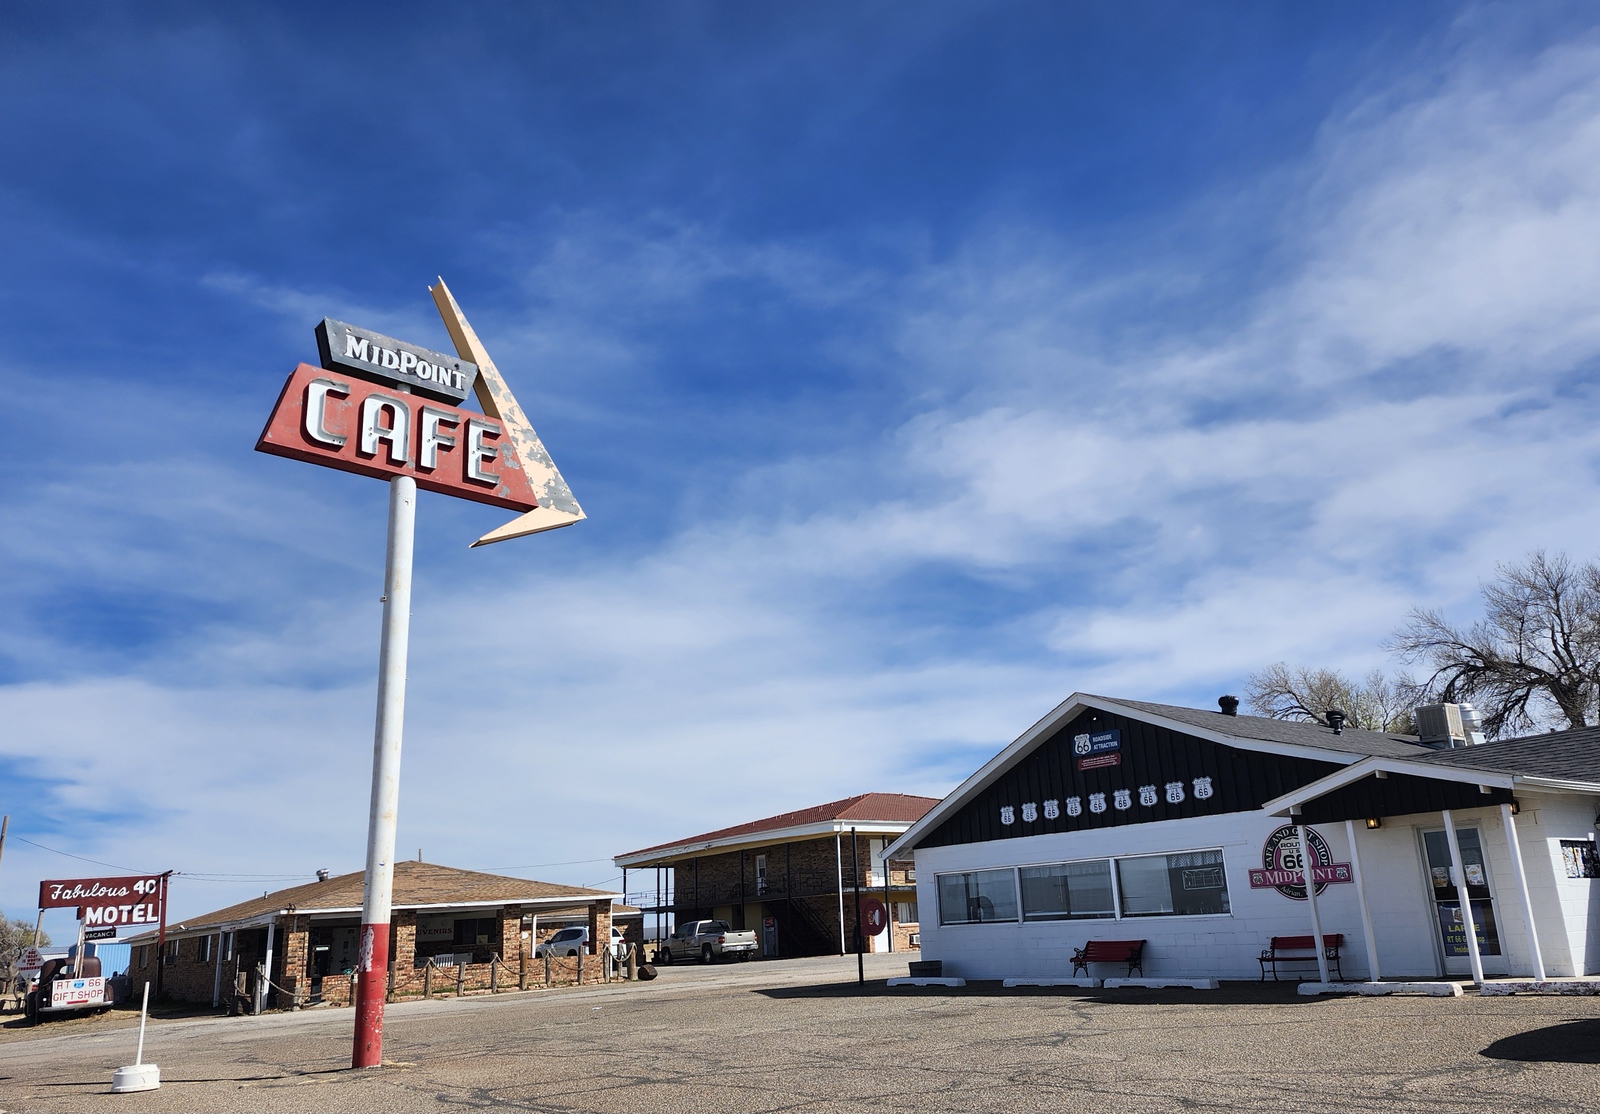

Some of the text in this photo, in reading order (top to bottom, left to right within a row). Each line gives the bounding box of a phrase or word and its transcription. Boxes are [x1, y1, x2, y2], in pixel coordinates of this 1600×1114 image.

[344, 334, 466, 390] MIDPOINT
[306, 378, 502, 484] CAFE
[1092, 734, 1112, 742] ROADSIDE
[1077, 741, 1090, 753] 66
[1093, 740, 1118, 750] ATTRACTION
[1171, 792, 1181, 801] 66
[1199, 788, 1209, 796] 66
[1118, 799, 1128, 808] 66
[1144, 796, 1153, 804] 66
[1093, 803, 1102, 811] 66
[1025, 812, 1033, 820] 66
[1047, 809, 1056, 817] 66
[1003, 815, 1011, 823] 66
[1265, 828, 1328, 870] CAFE AND GT SHOP
[1265, 867, 1334, 885] MIDPINT
[49, 879, 157, 900] Fabulous 40
[86, 903, 158, 925] MOTEL
[417, 928, 453, 936] UVENIRS
[1448, 924, 1480, 932] LARE
[88, 978, 101, 987] 66
[53, 989, 104, 1002] GIFT SHOP
